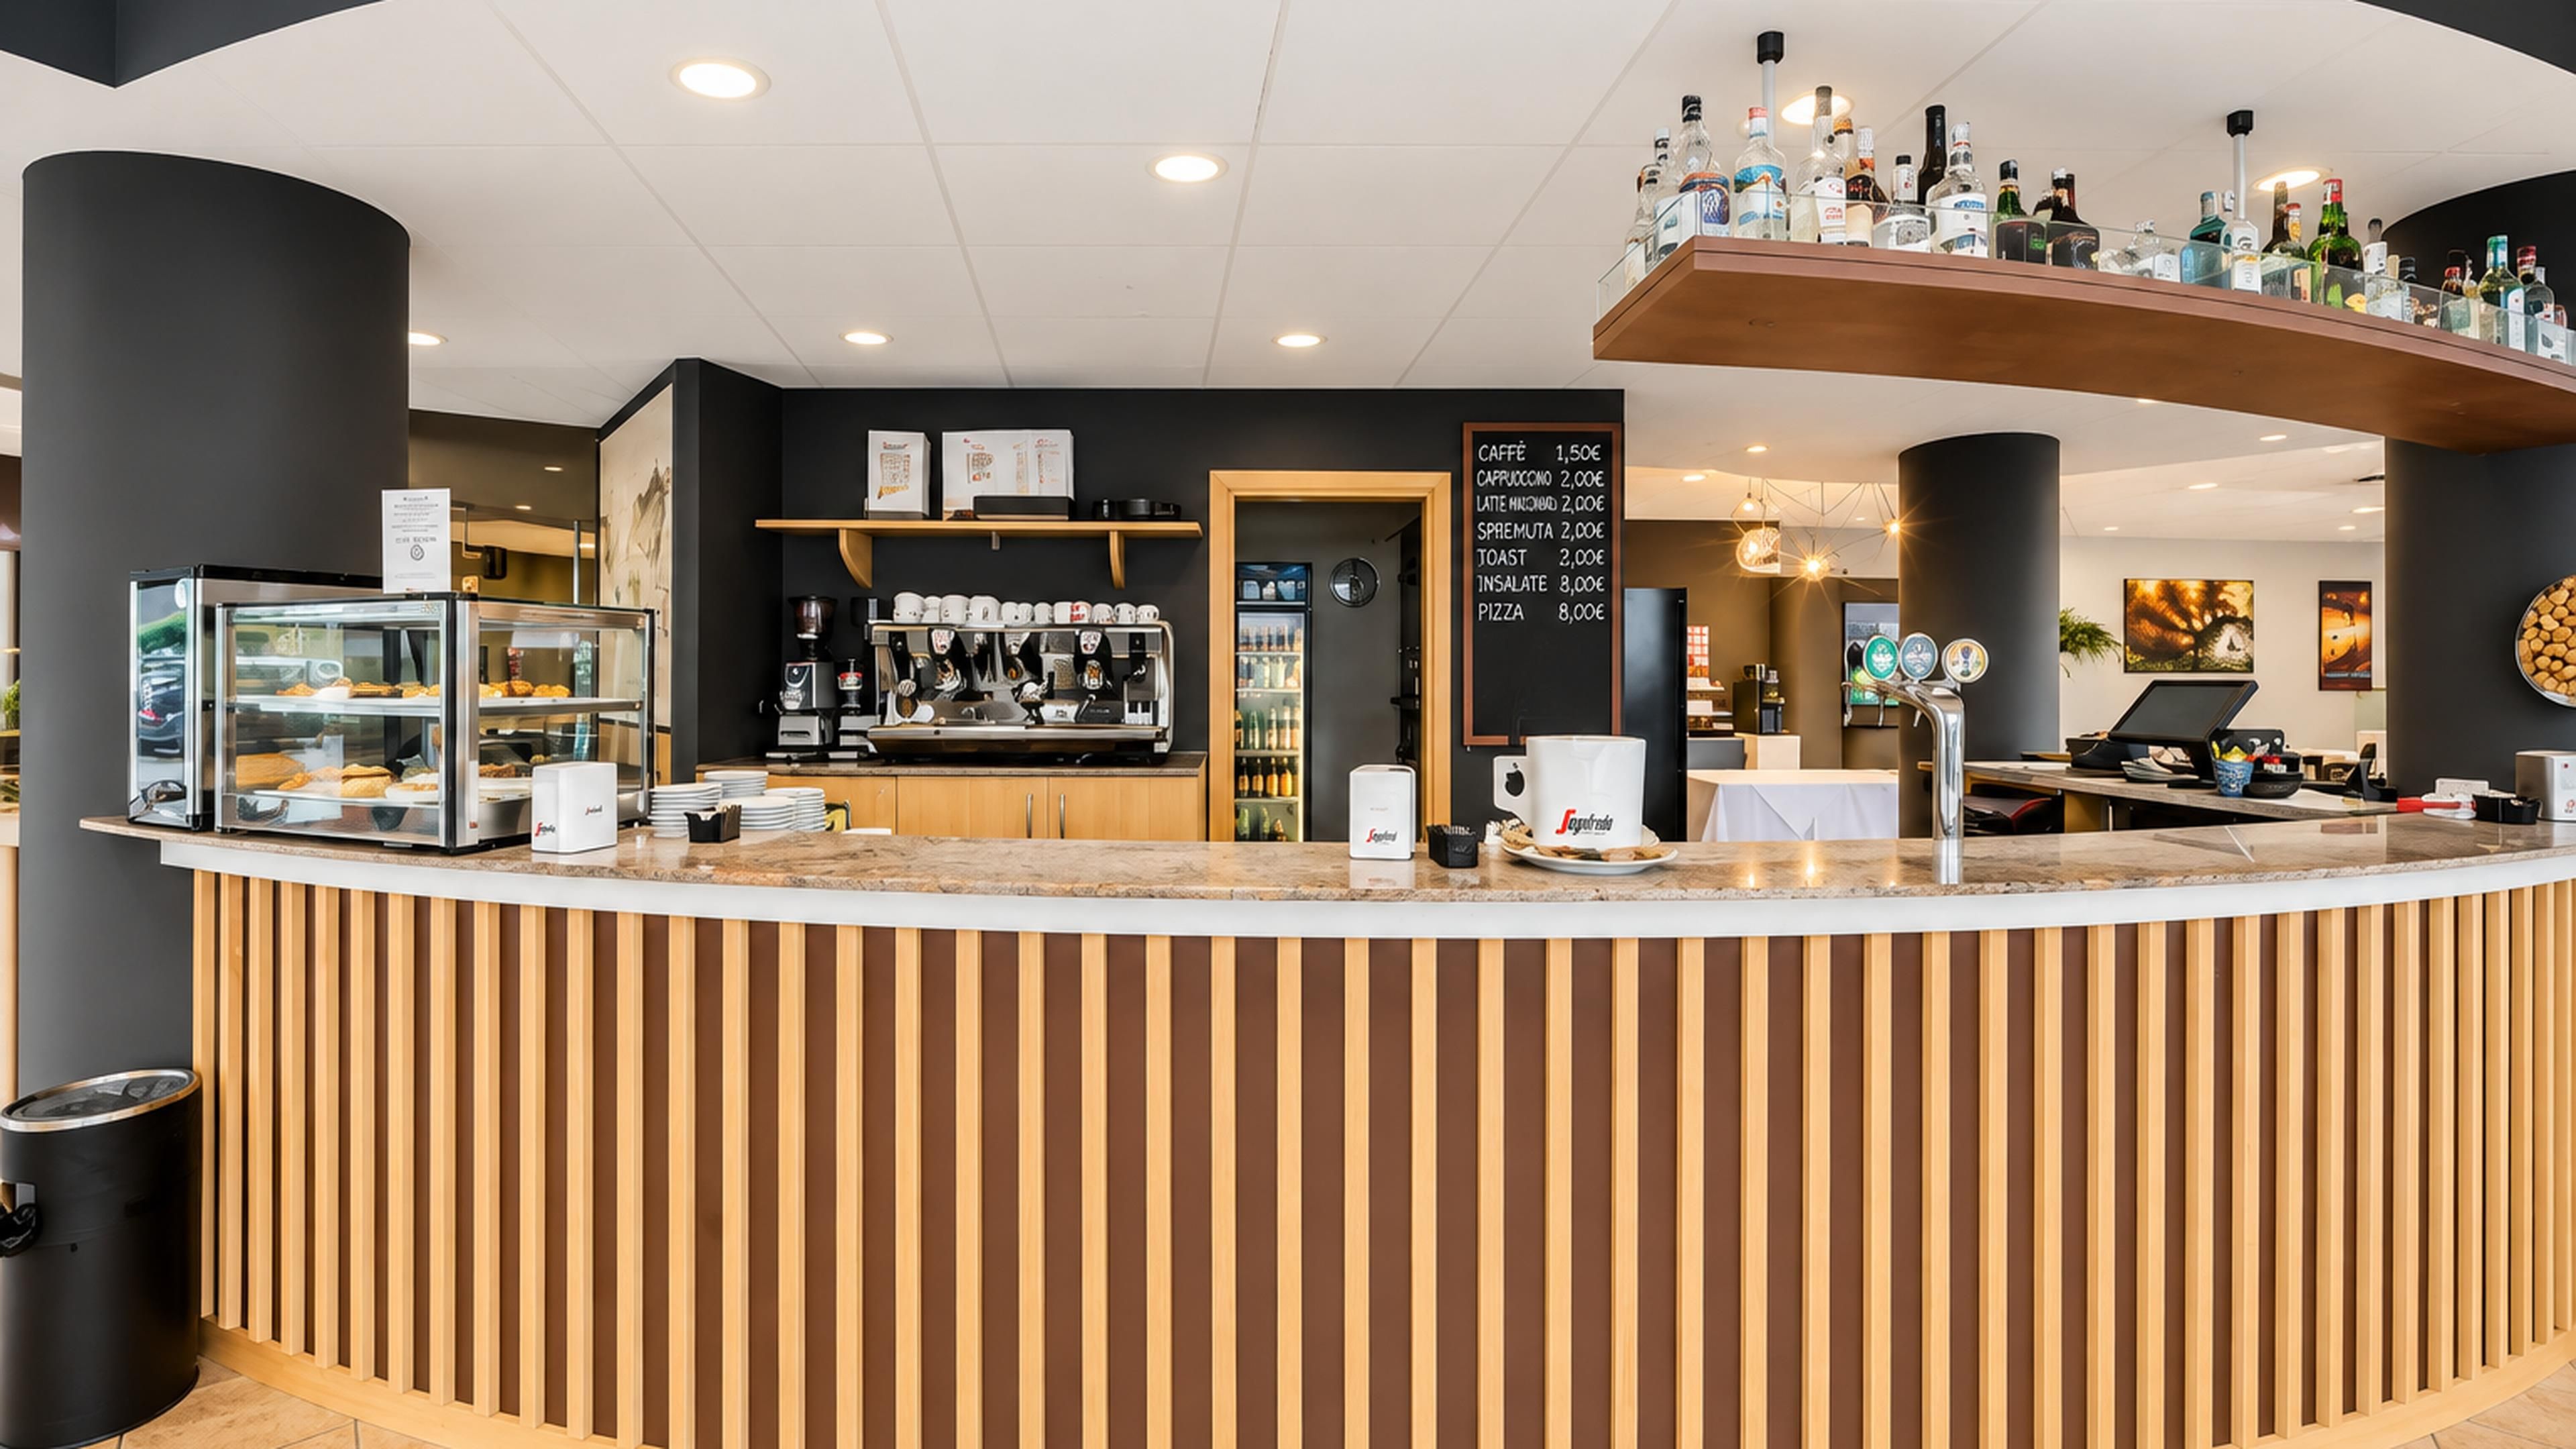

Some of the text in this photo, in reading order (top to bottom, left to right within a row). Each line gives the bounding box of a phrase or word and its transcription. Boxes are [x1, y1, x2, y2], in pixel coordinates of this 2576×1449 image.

[1556, 444, 1601, 464] 1,50€
[1560, 470, 1605, 490] 2,00€
[1561, 494, 1605, 515] 2,00€
[1560, 521, 1605, 542] 2,00€
[1477, 547, 1605, 569] TOAST 2,00€
[1477, 574, 1605, 596] INSALATE 8,00€
[1479, 602, 1605, 625] PIZZA 8,00€
